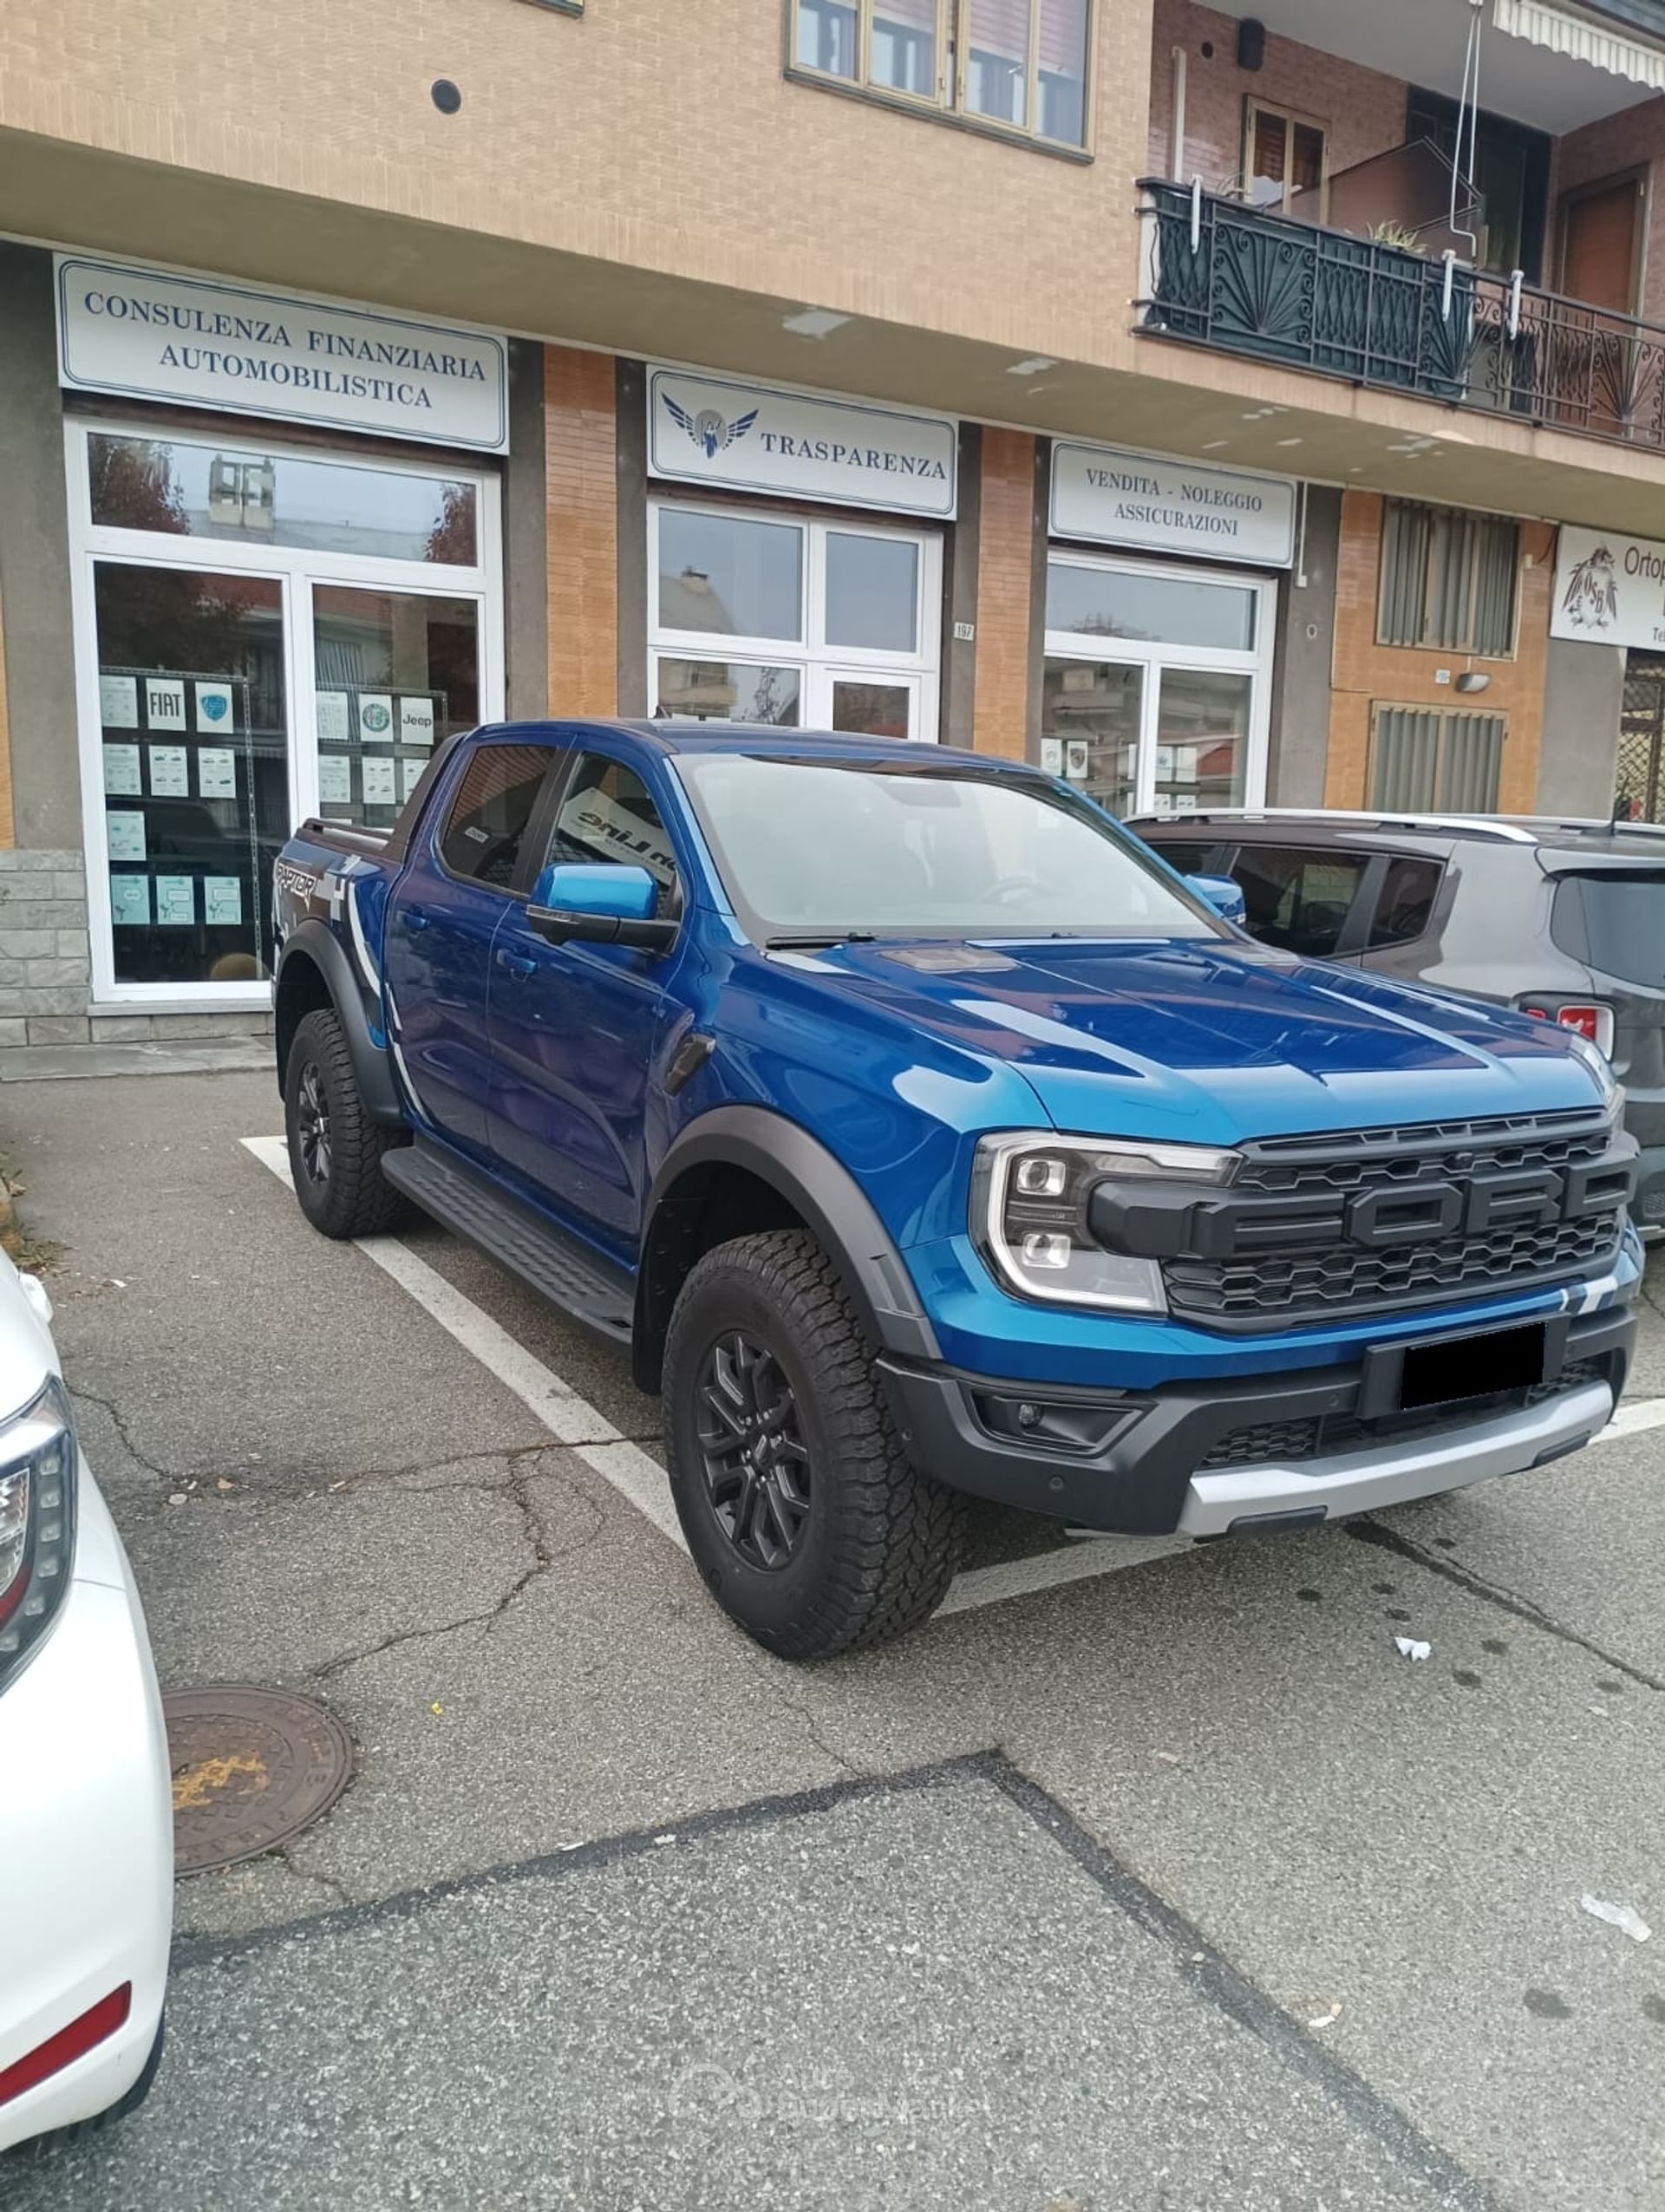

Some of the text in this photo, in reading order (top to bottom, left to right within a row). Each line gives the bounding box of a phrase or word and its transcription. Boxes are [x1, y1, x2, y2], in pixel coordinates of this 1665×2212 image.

[85, 291, 486, 382] CONSULENZA FINANZIARIA
[159, 344, 432, 408] AUTOMOBILISTICA
[761, 433, 946, 480] TRASPARENZA
[1086, 468, 1160, 496] VENDITA
[1180, 484, 1262, 512] NOLEGGIO
[1114, 503, 1237, 536] ASSICURAZIONI
[149, 692, 181, 718] FIAT
[402, 714, 432, 728] Jeep
[277, 862, 317, 911] RAPTOR
[1202, 1164, 1637, 1257] FORD
